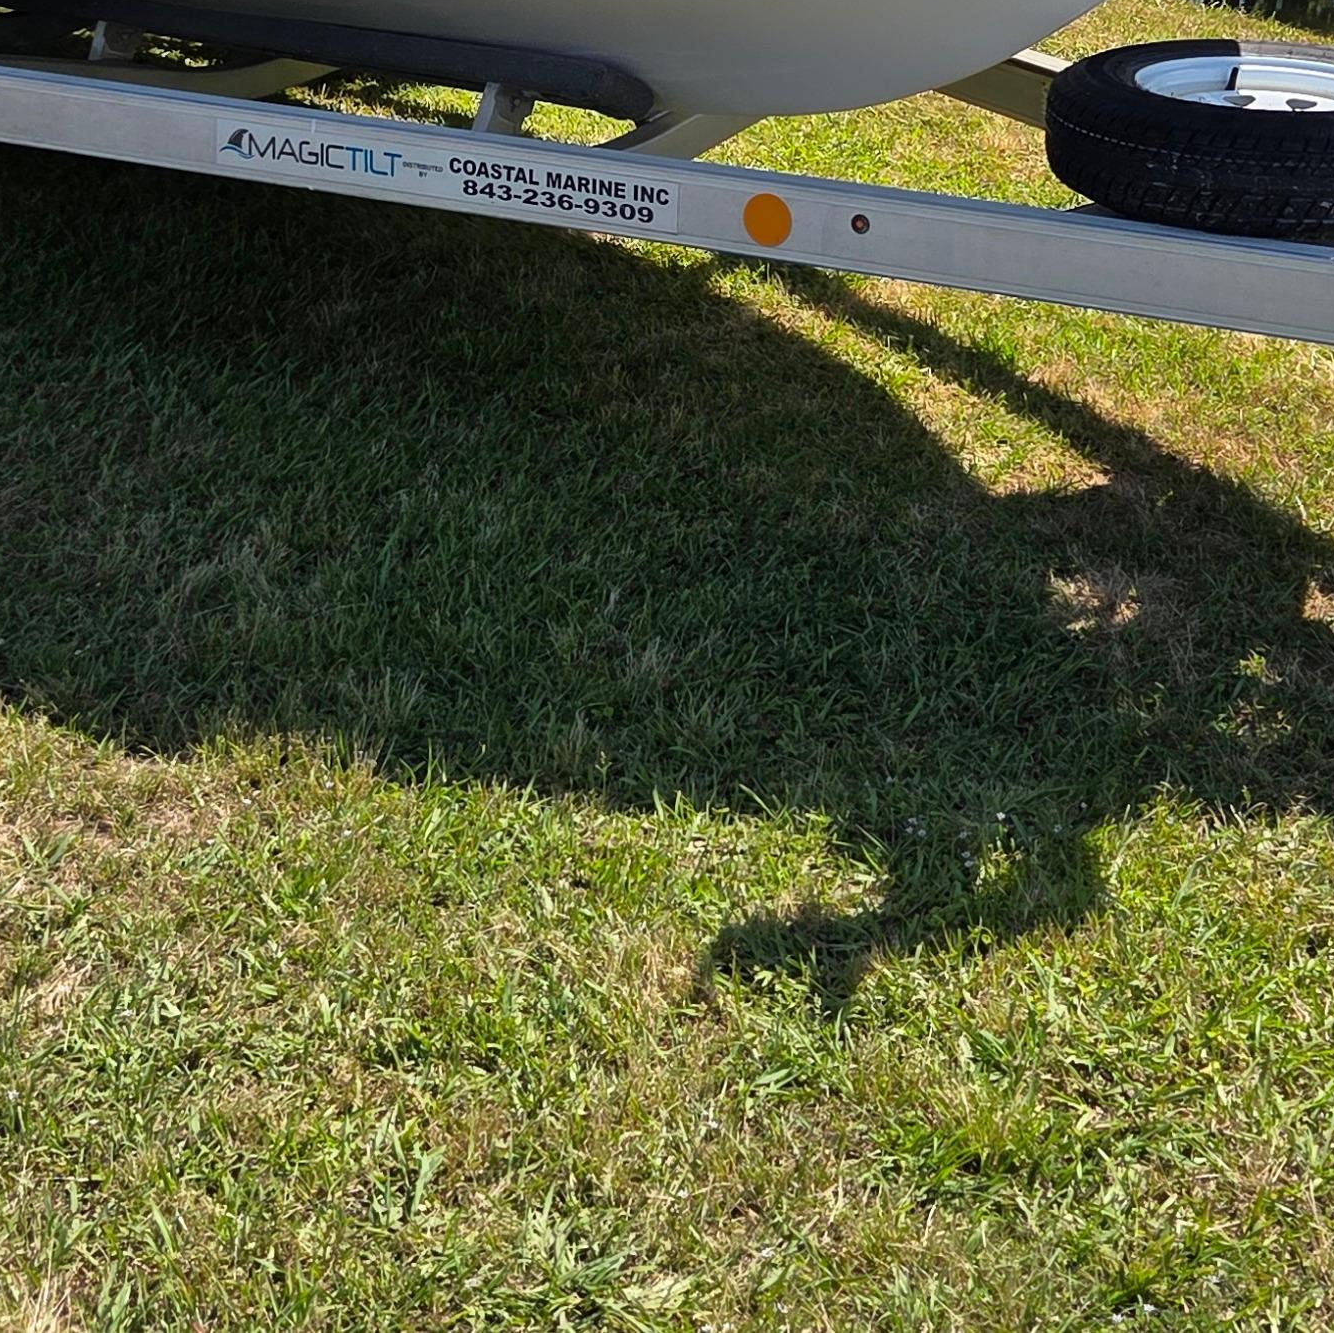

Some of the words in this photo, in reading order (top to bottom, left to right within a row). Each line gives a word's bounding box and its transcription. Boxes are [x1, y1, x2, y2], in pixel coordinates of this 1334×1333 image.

[248, 132, 403, 178] MAGICTILT
[449, 157, 540, 186] COASTAL
[546, 171, 626, 200] MARINE
[633, 185, 670, 206] INC
[462, 179, 654, 224] 843-236-9309
